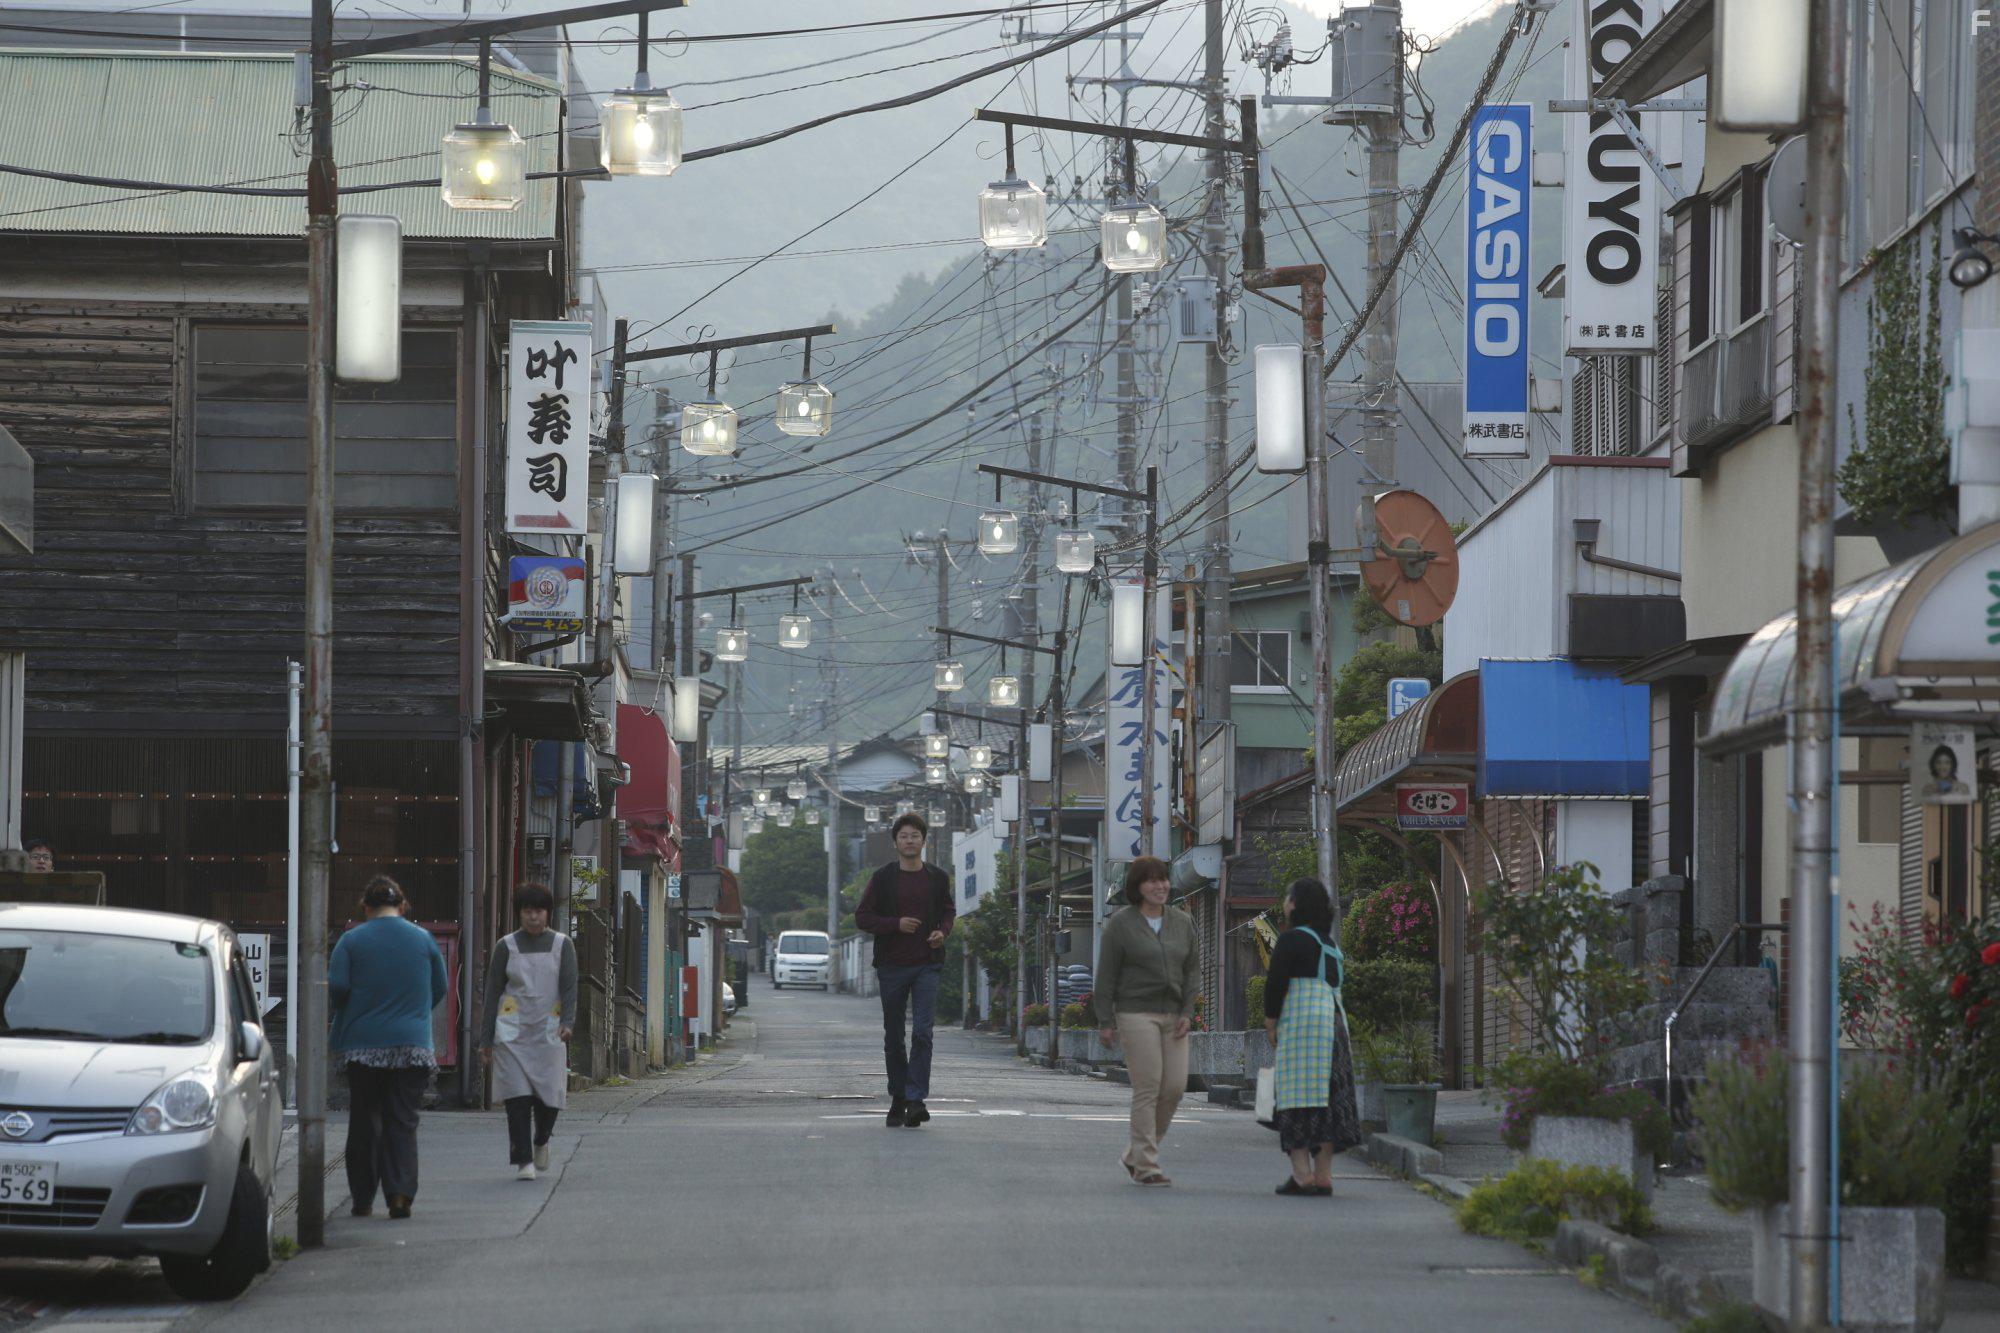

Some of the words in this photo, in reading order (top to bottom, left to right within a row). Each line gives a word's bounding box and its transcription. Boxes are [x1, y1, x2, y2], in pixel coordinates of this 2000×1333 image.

[1474, 119, 1523, 358] CASIO
[1411, 793, 1451, 811] たばこ
[1403, 815, 1428, 826] MILD
[1429, 815, 1460, 826] SEVEN
[0, 1178, 50, 1201] 5-69
